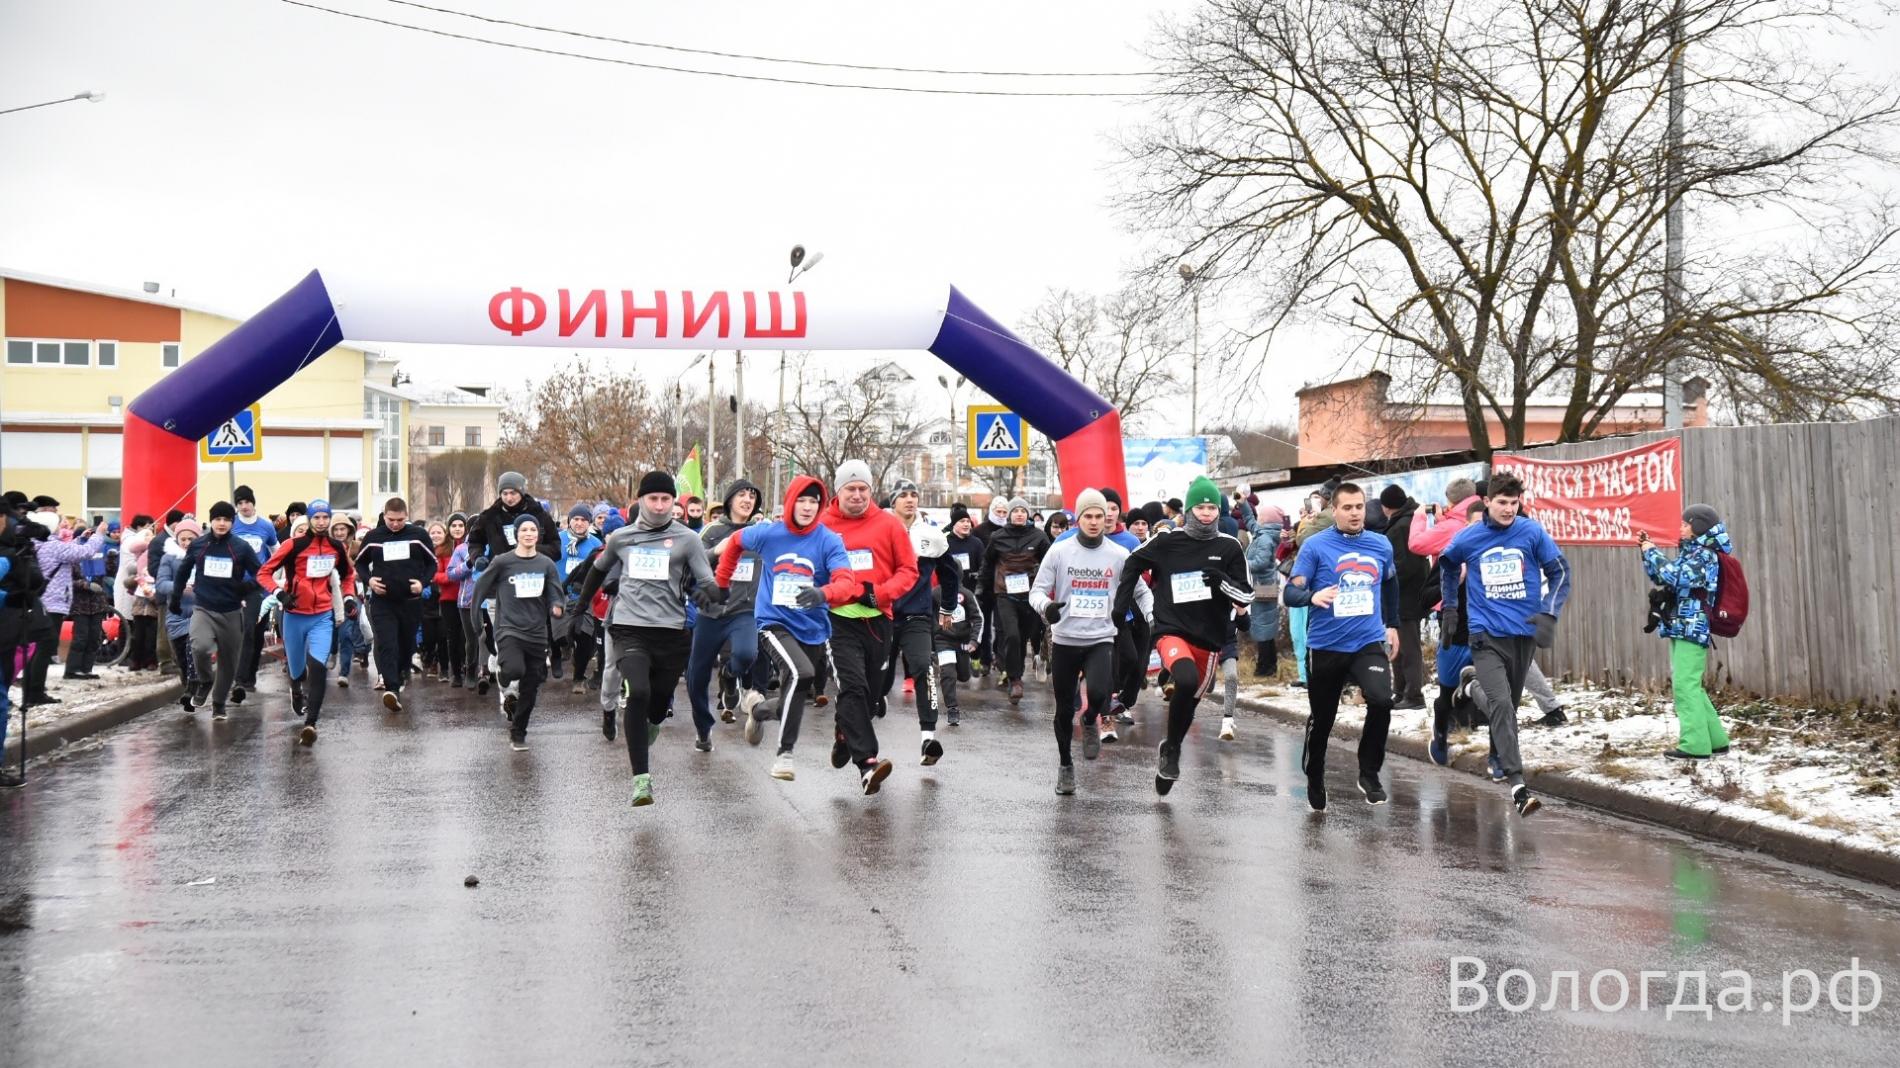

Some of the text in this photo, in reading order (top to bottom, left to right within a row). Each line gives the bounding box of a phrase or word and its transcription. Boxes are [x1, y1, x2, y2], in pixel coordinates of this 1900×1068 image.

[488, 287, 807, 338] ФИНИШ
[1588, 449, 1677, 498] УЧАСТОК
[634, 556, 662, 569] 2221
[1487, 562, 1516, 575] 2229
[1067, 566, 1103, 577] Reebok
[778, 583, 803, 594] 222
[1485, 582, 1526, 593] ЕДИНАЯ
[1339, 593, 1368, 606] 2234
[1485, 590, 1527, 600] РОССИЯ
[1075, 598, 1104, 609] 2255
